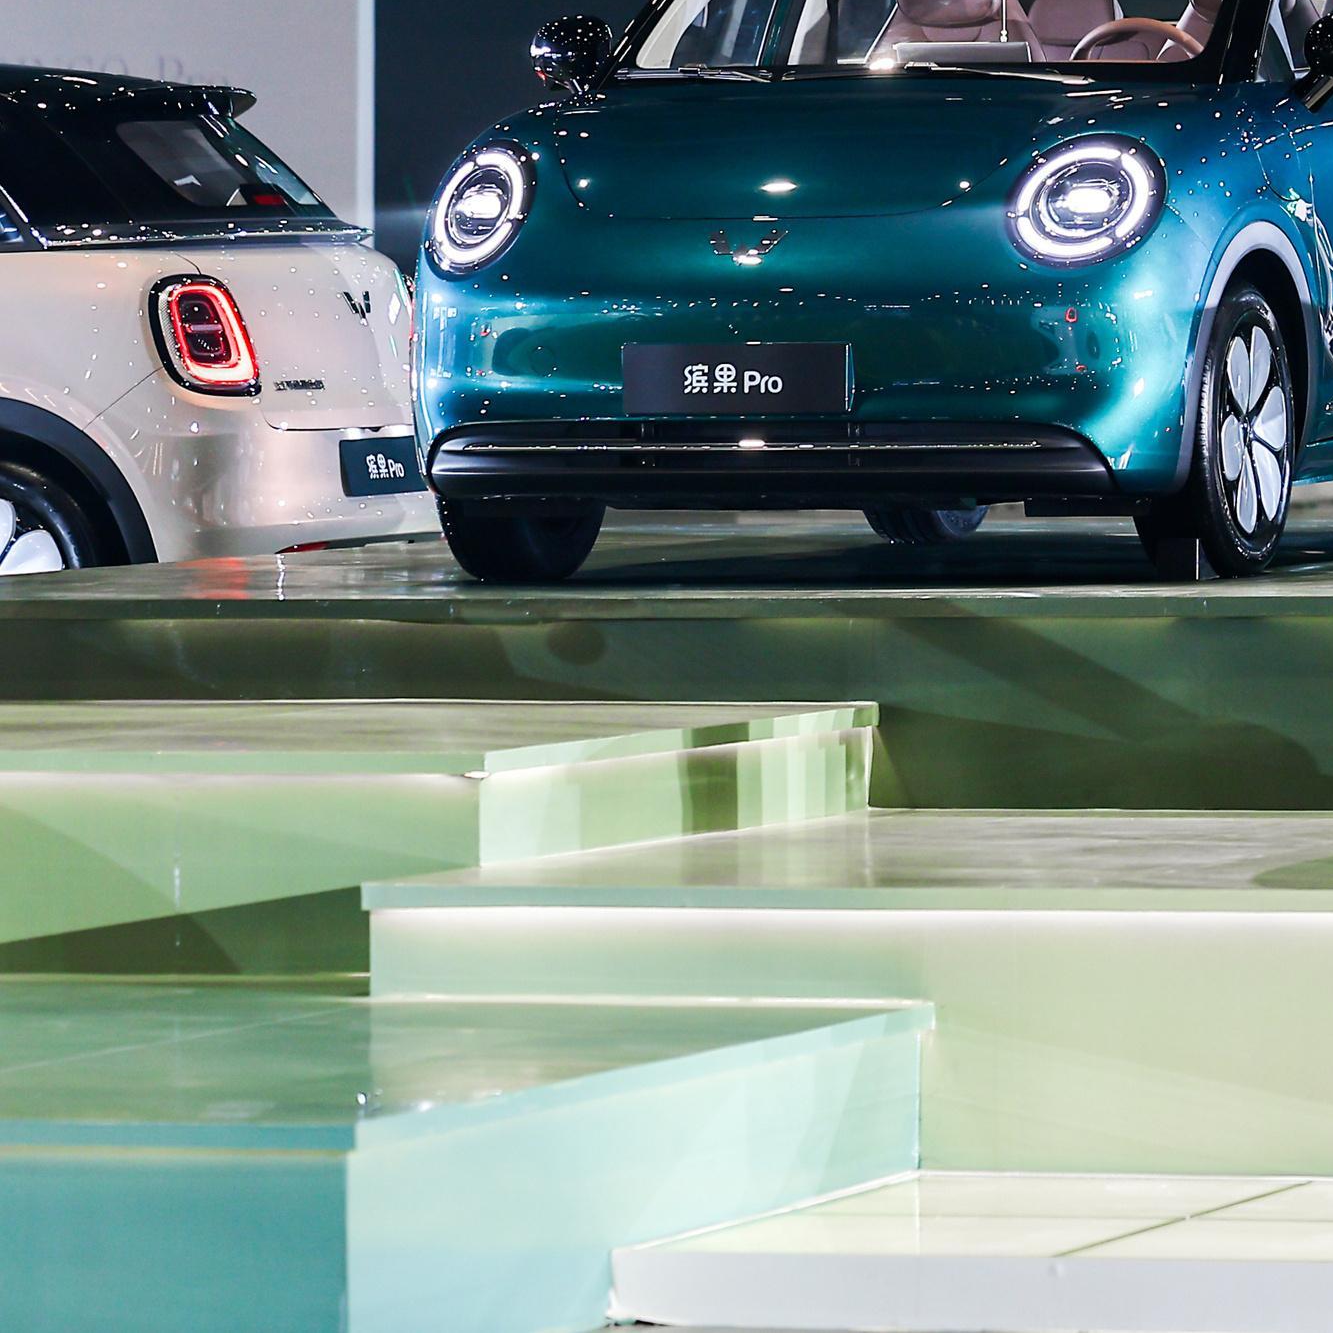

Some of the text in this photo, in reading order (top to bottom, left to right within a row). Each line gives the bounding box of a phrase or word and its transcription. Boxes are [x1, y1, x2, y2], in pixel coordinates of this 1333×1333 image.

[683, 363, 783, 394] 缤果 Pro
[387, 458, 405, 478] Pro
